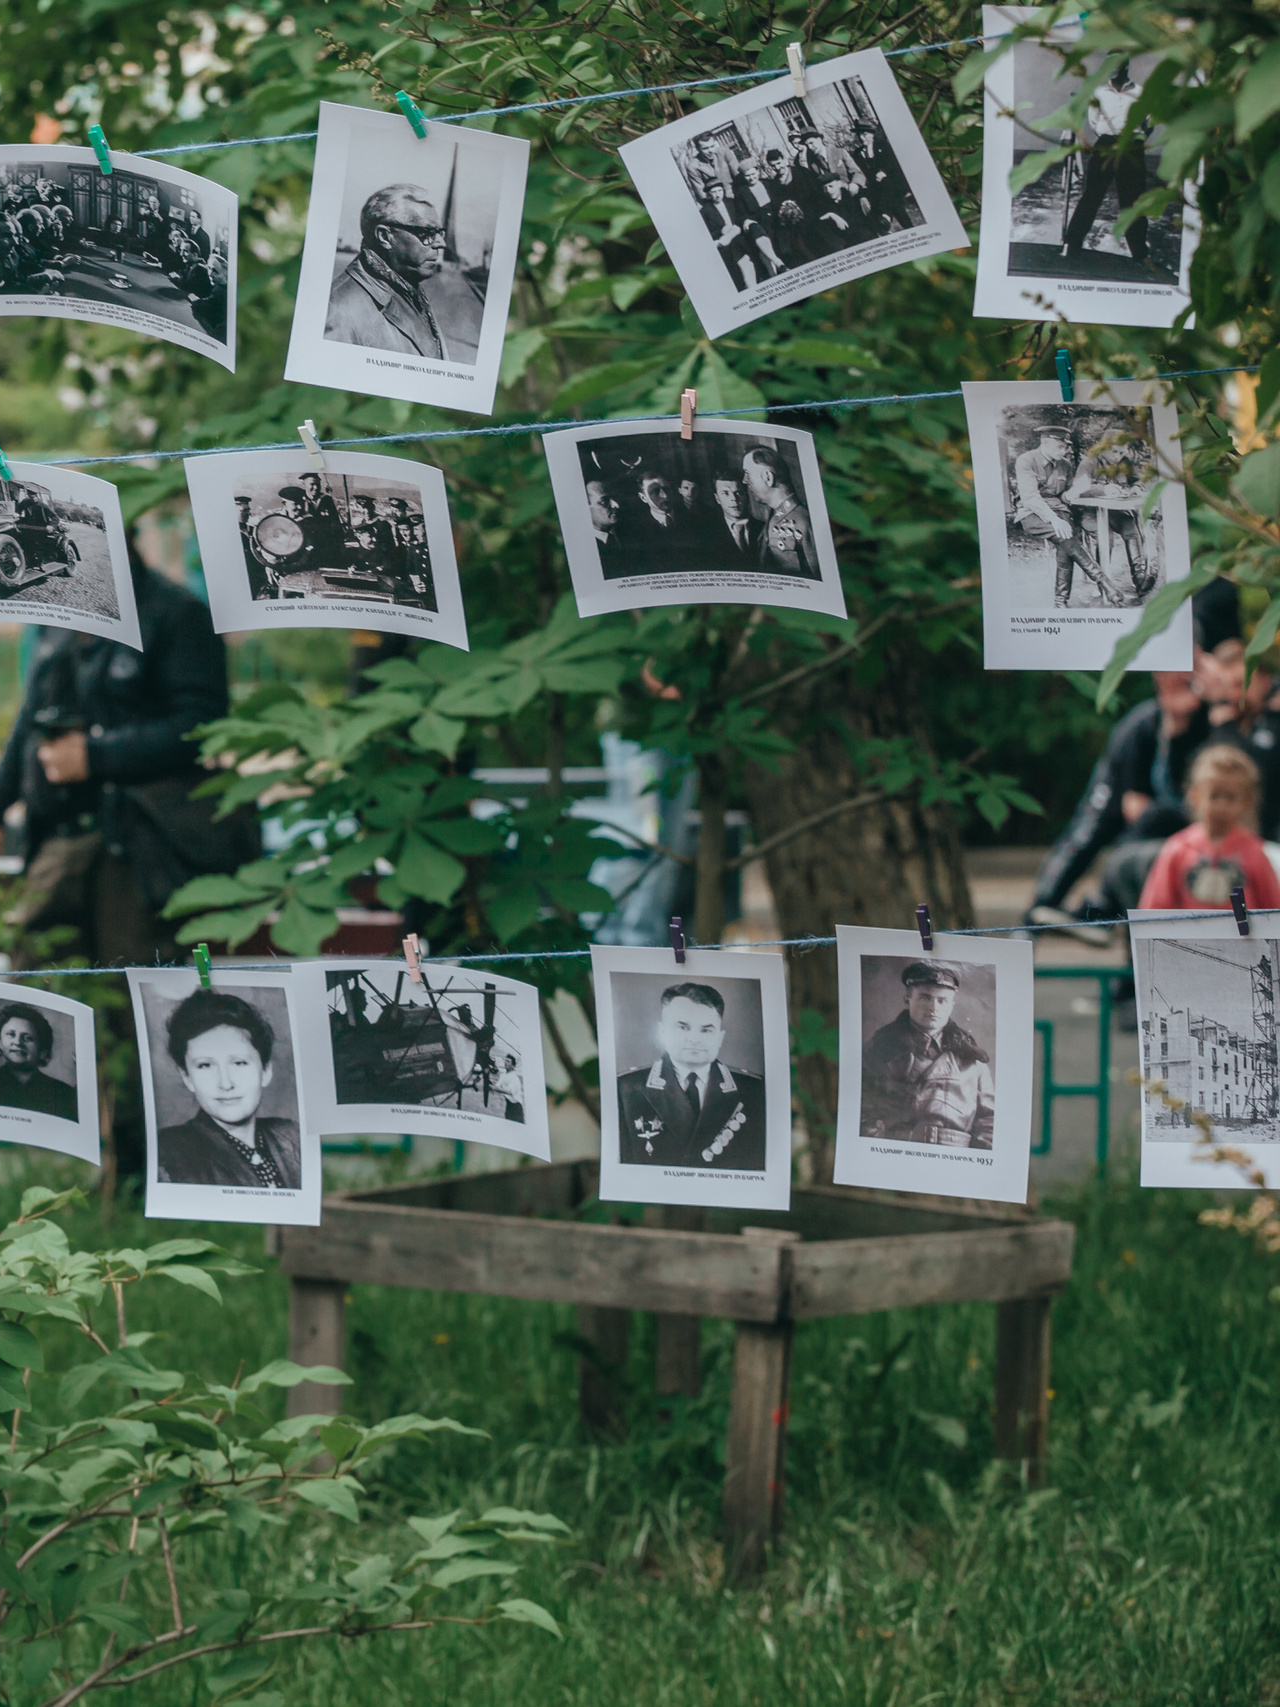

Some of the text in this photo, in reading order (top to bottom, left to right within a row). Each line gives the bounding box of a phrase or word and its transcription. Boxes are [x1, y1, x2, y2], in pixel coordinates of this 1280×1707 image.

[1057, 284, 1095, 292] ВЛАДИМИР
[1096, 286, 1142, 295] НИКОЛАЕВИЧ
[366, 358, 401, 369] ВЛАДИМИР
[403, 364, 446, 377] НИКОЛАЕВИЧ
[6, 601, 44, 610] АВТОМОБИЛЬ
[266, 604, 295, 612] СТАРШИЙ
[331, 605, 364, 613] АЛЕКСАНДР
[1043, 627, 1061, 635] 1941
[870, 1146, 903, 1154] ВЛАДИМИР
[904, 1150, 940, 1159] ЯКОВЛЕВИЧ
[976, 1157, 994, 1166] 1937
